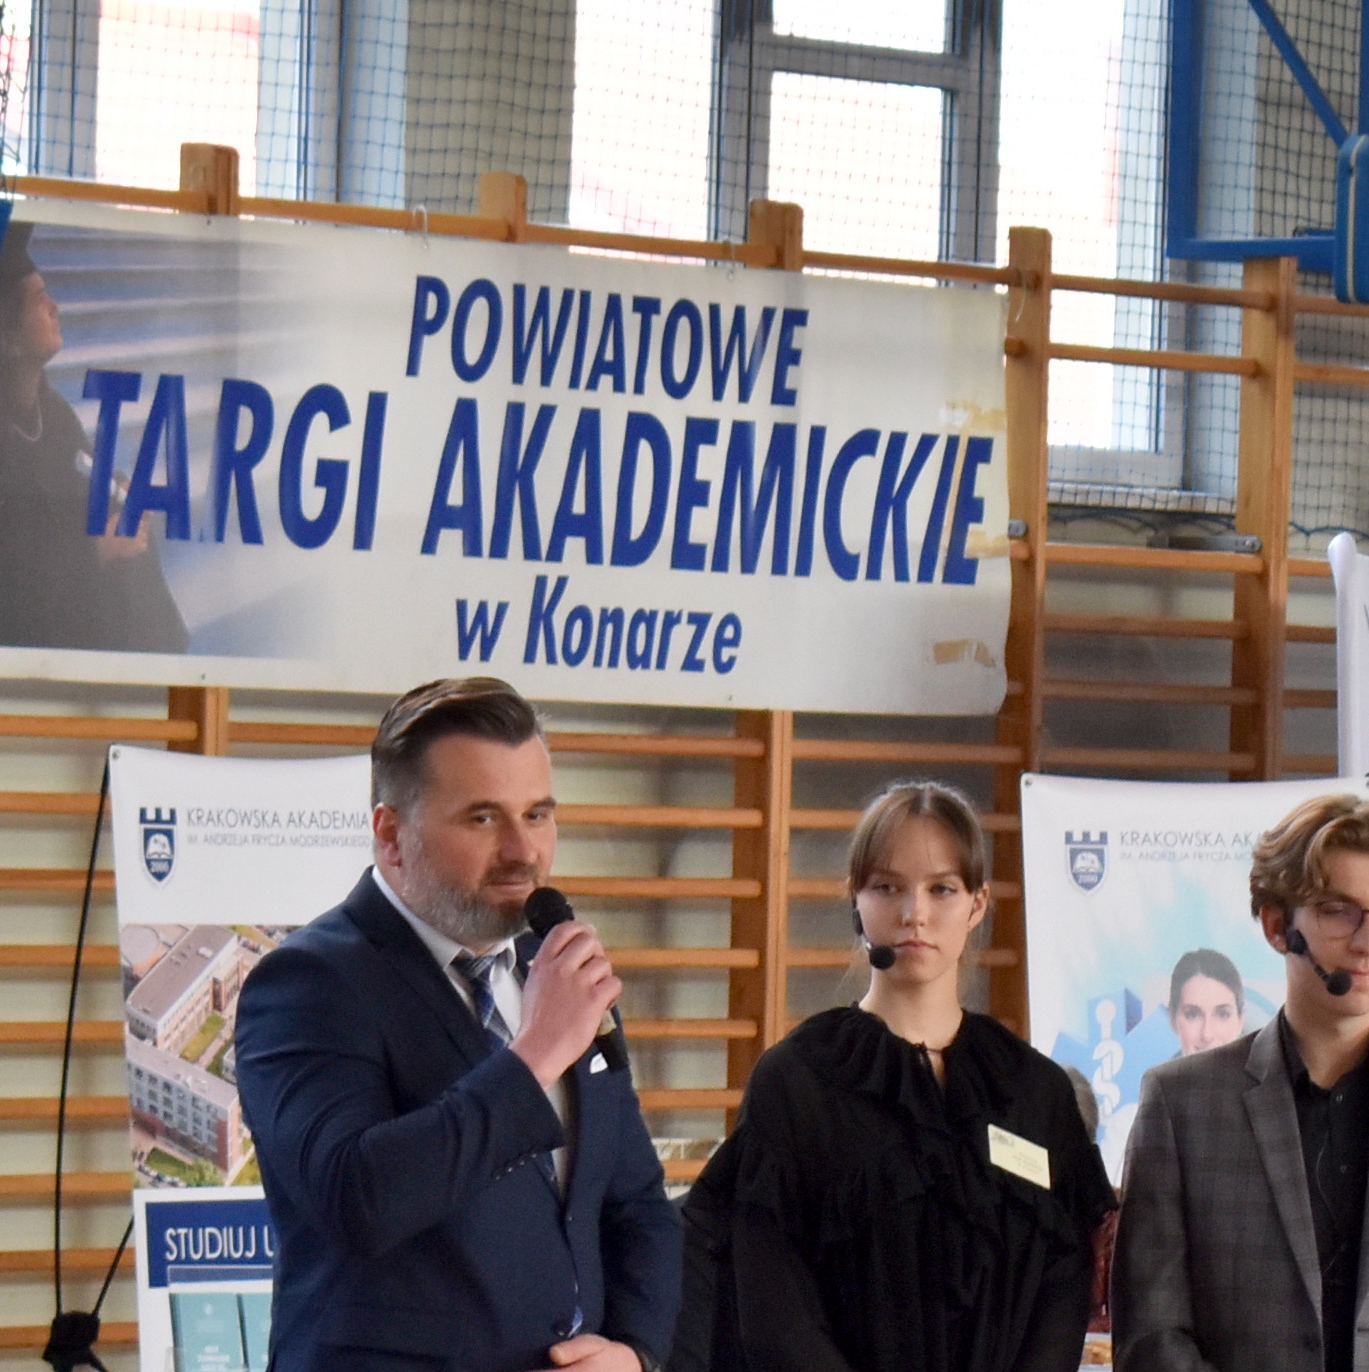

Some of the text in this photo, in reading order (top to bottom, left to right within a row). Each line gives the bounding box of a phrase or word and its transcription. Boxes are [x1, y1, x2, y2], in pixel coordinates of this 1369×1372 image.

[406, 274, 809, 407] POWIATOWE
[82, 369, 994, 586] TARGI AKADEMICKIE
[455, 576, 742, 676] w Konarze
[187, 807, 370, 830] KRAKOWSKA AKADEMIA
[1119, 830, 1226, 848] KRAKOWSKA
[165, 1225, 257, 1261] STUDIUJ
